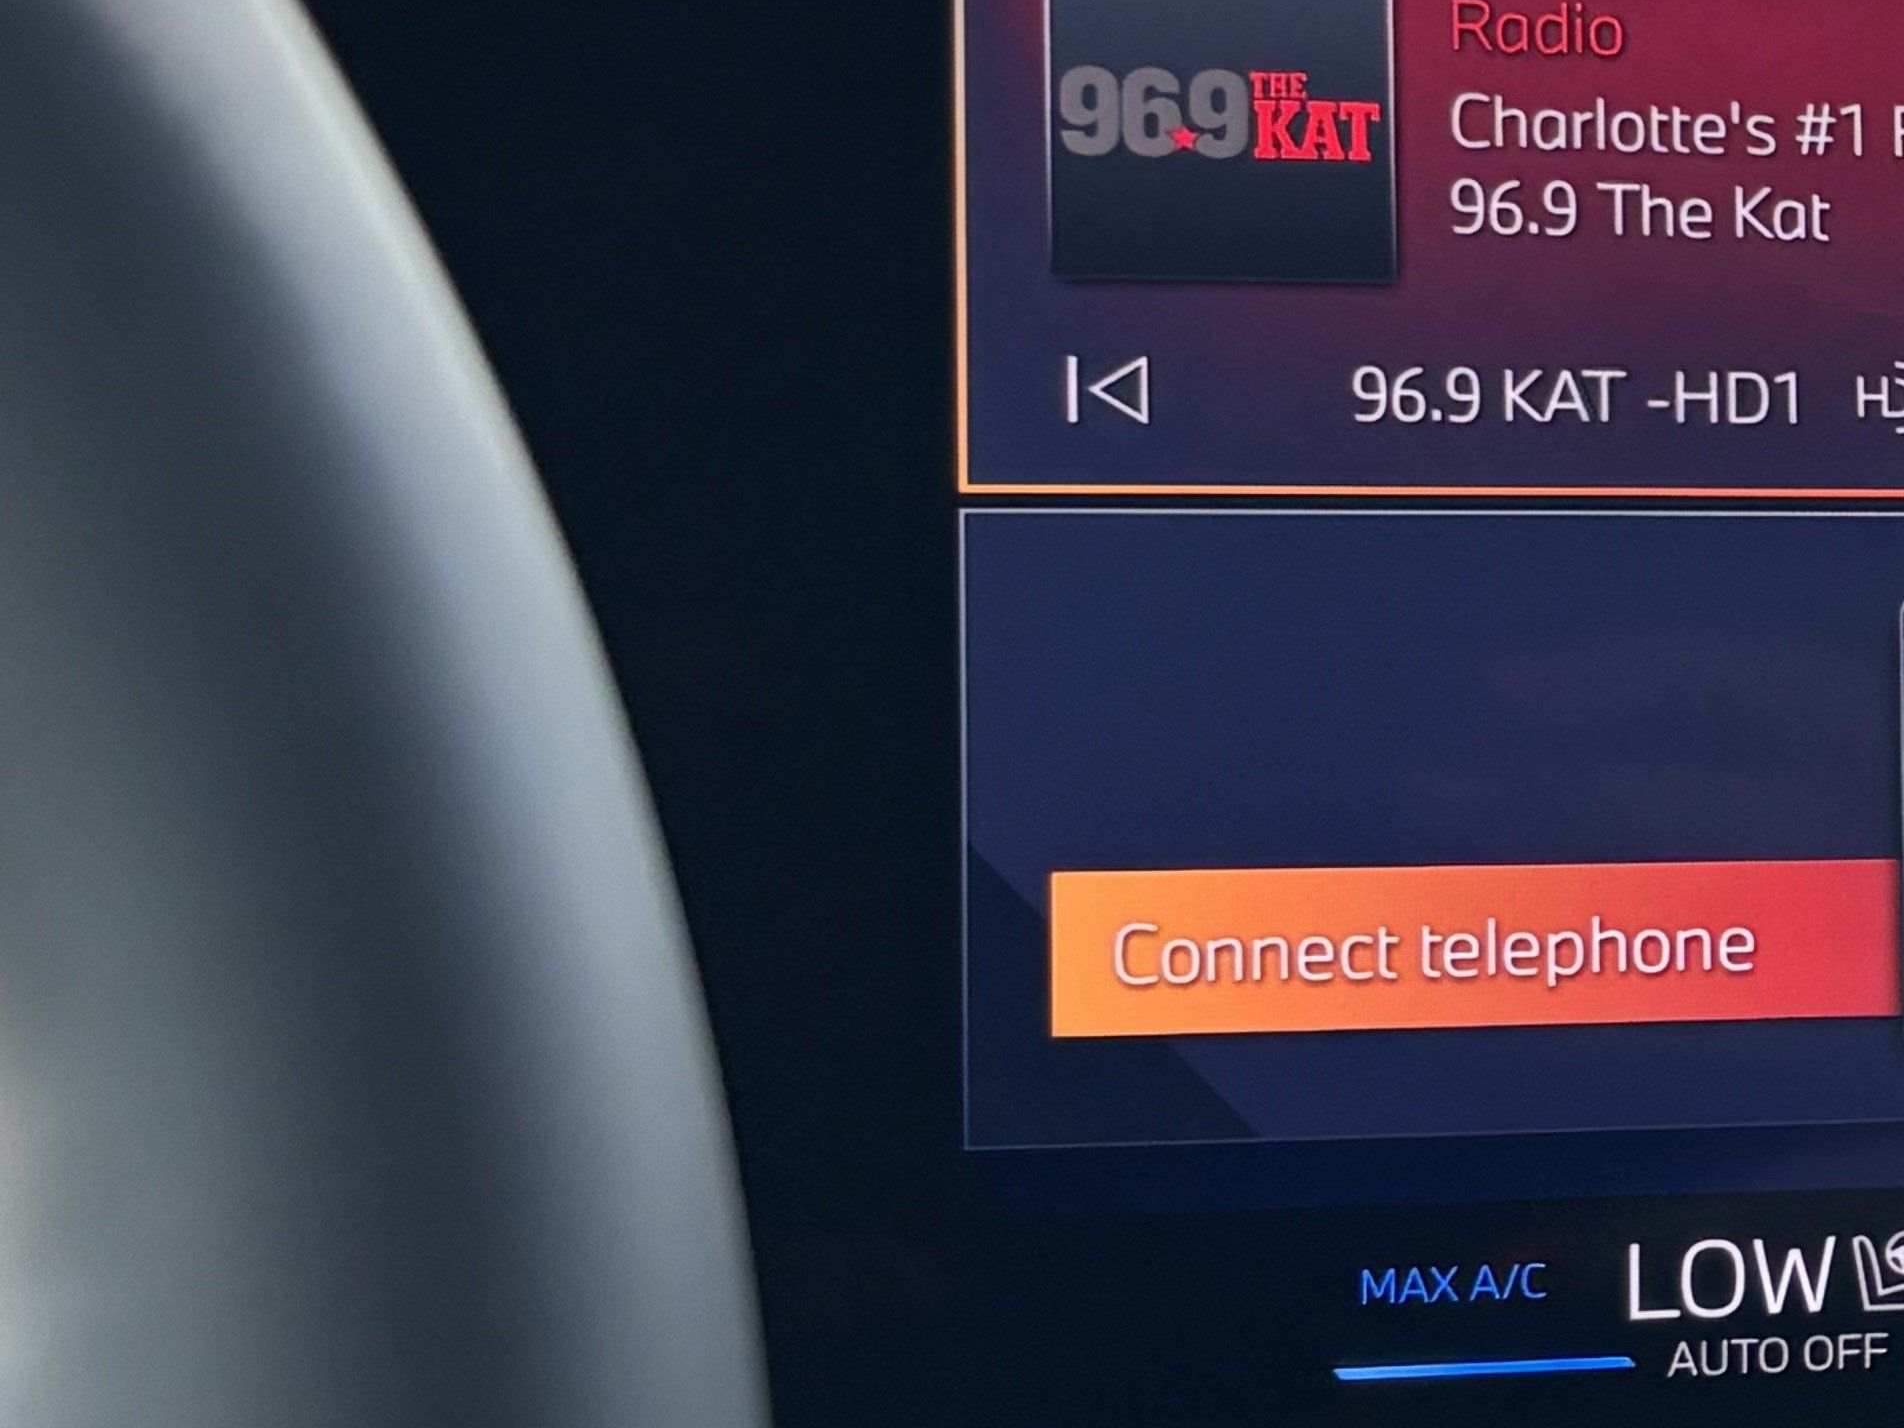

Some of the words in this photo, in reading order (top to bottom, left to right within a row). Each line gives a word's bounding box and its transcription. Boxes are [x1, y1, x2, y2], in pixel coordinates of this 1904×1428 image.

[1249, 70, 1308, 101] THE
[1252, 99, 1381, 162] KAT
[1451, 92, 1776, 156] Charlotte's
[1795, 103, 1863, 157] #1
[1450, 177, 1577, 236] 96.9
[1596, 181, 1713, 239] The
[1734, 185, 1831, 242] Kat
[1352, 365, 1481, 423] 96.9
[1503, 368, 1627, 422] KAT
[1647, 370, 1798, 424] -HD1
[1114, 922, 1399, 985] Connect
[1421, 915, 1755, 987] telephone
[1360, 1266, 1459, 1305] MAX
[1469, 1262, 1547, 1301] A/C
[1628, 1235, 1836, 1321] LOW
[1667, 1336, 1790, 1378] AUTO
[1803, 1332, 1889, 1372] OFF
